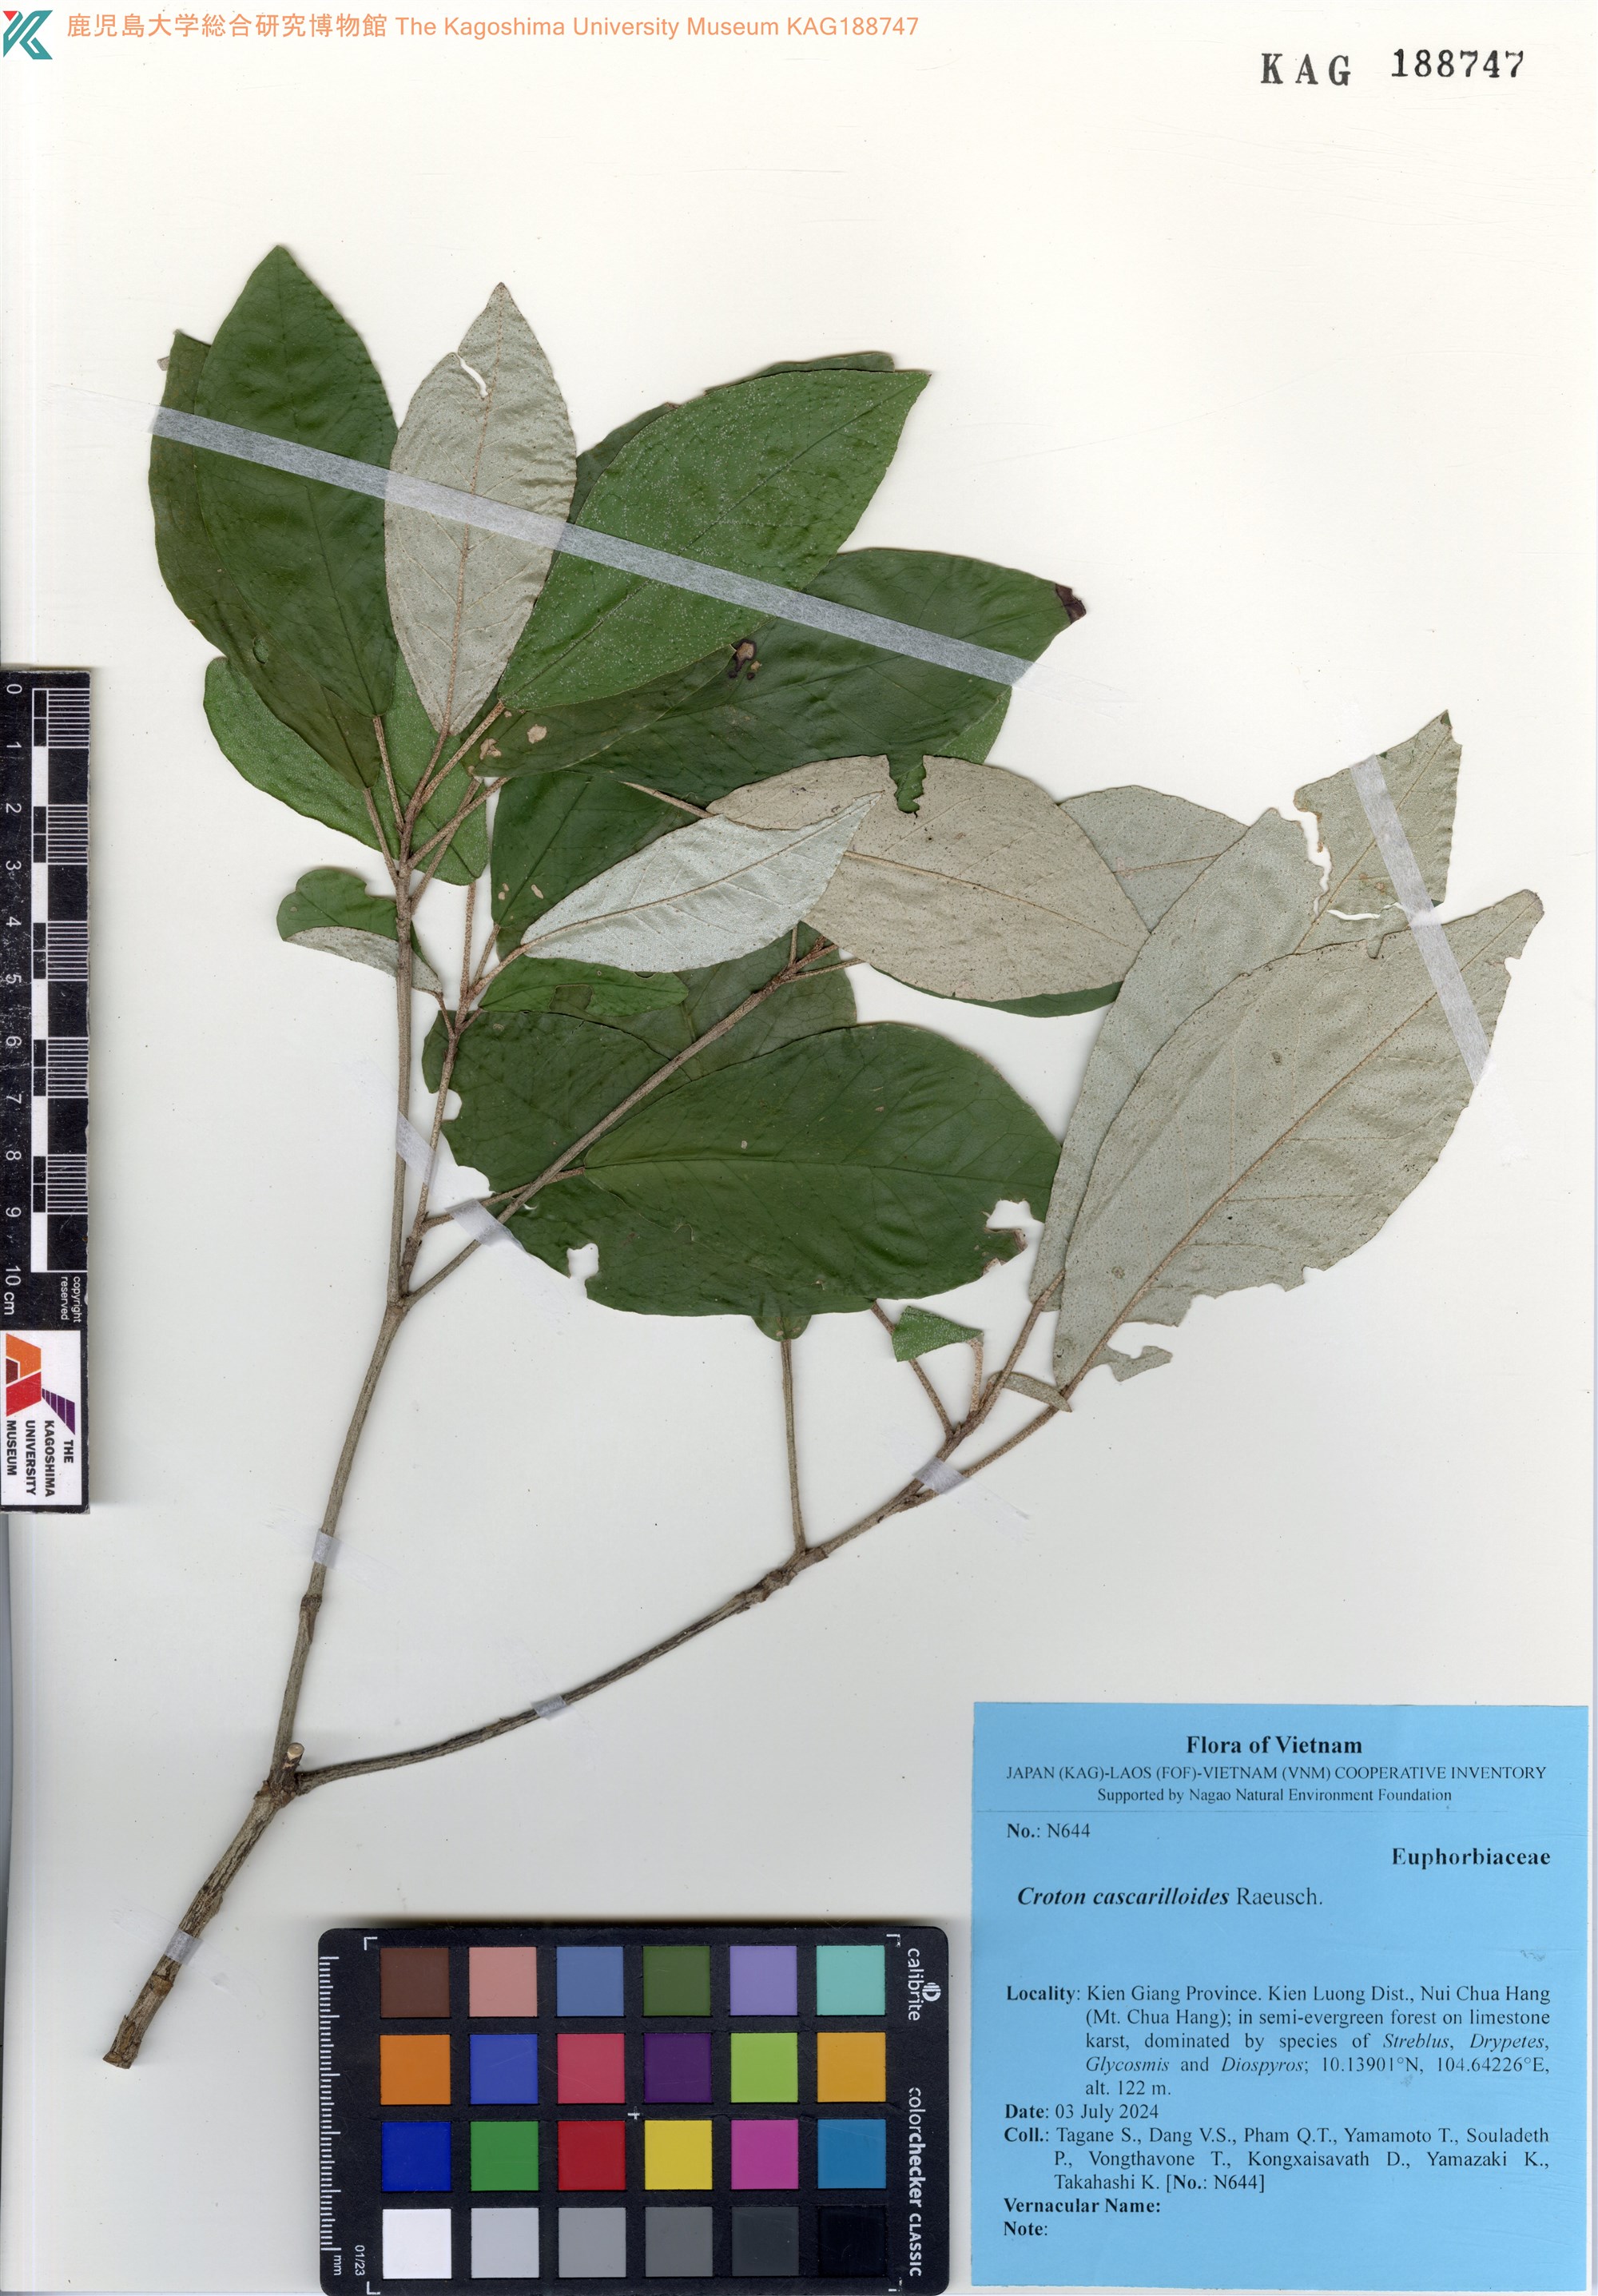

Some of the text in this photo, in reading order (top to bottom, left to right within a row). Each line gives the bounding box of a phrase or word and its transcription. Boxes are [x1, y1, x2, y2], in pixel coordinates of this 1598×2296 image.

[1260, 48, 1524, 86] KAG 188747
[6, 683, 22, 694] 0
[6, 803, 22, 814] 2
[6, 860, 22, 871] 3
[6, 916, 22, 927] 4
[6, 973, 22, 984] 5
[6, 1036, 22, 1047] 6
[6, 1094, 22, 1104] 7
[6, 1150, 22, 1161] 8
[6, 1207, 22, 1218] 9
[5, 1265, 22, 1286] 10
[3, 1291, 15, 1315] cm
[60, 1275, 69, 1320] reserved
[71, 1275, 81, 1323] copyright
[6, 1419, 17, 1476] MUSEUM
[25, 1419, 36, 1496] UNIVERSITY
[63, 1439, 74, 1463] THE
[44, 1419, 55, 1498] KAGOSHIMA
[1187, 1735, 1362, 1754] Flora of Vietnam
[1006, 1766, 1547, 1782] JAPAN (KAG)-LAOS (FOF)-VIETNAM (VNM) COOPERATIVE INVENTORY
[1097, 1788, 1452, 1805] Supported by Nagao Natural Environment Foundation
[1007, 1823, 1091, 1839] No.: N644
[1393, 1847, 1551, 1870] Euphorbiaceae
[1017, 1886, 1323, 1905] Croton cascarilloides Raeusch.
[907, 1948, 924, 2021] calibrite
[1007, 1984, 1551, 2006] Locality: Kien Giang Province. Kien Luong Dist., Nui Chua Hang
[1086, 2008, 1550, 2029] (Mt. Chua Hang); in semi-evergreen forest on limestone
[1086, 2032, 1549, 2053] karst, dominated by species of Streblus, Drypetes,
[1086, 2055, 1170, 2076] Glycosmis
[1180, 2056, 1209, 2072] and
[1221, 2056, 1309, 2076] Diospyros;
[1085, 2079, 1171, 2095] alt. 122 m.
[1004, 2103, 1159, 2123] Date: 03 July 2024
[1004, 2127, 1549, 2147] Coll.: Tagane S., Dang V.S., Pham Q.T., Yamamoto T., Souladeth
[1055, 2150, 1549, 2171] P., Vongthavone T., Kongxaisavath D., Yamazaki K.,
[908, 2087, 926, 2278] colorchecker CLASSIC
[1054, 2174, 1265, 2194] Takahashi K. [No.: N644]
[1003, 2197, 1160, 2213] Vernacular Name:
[1004, 2221, 1047, 2236] Note:
[333, 2254, 342, 2276] mm
[354, 2244, 366, 2276] 01/23
